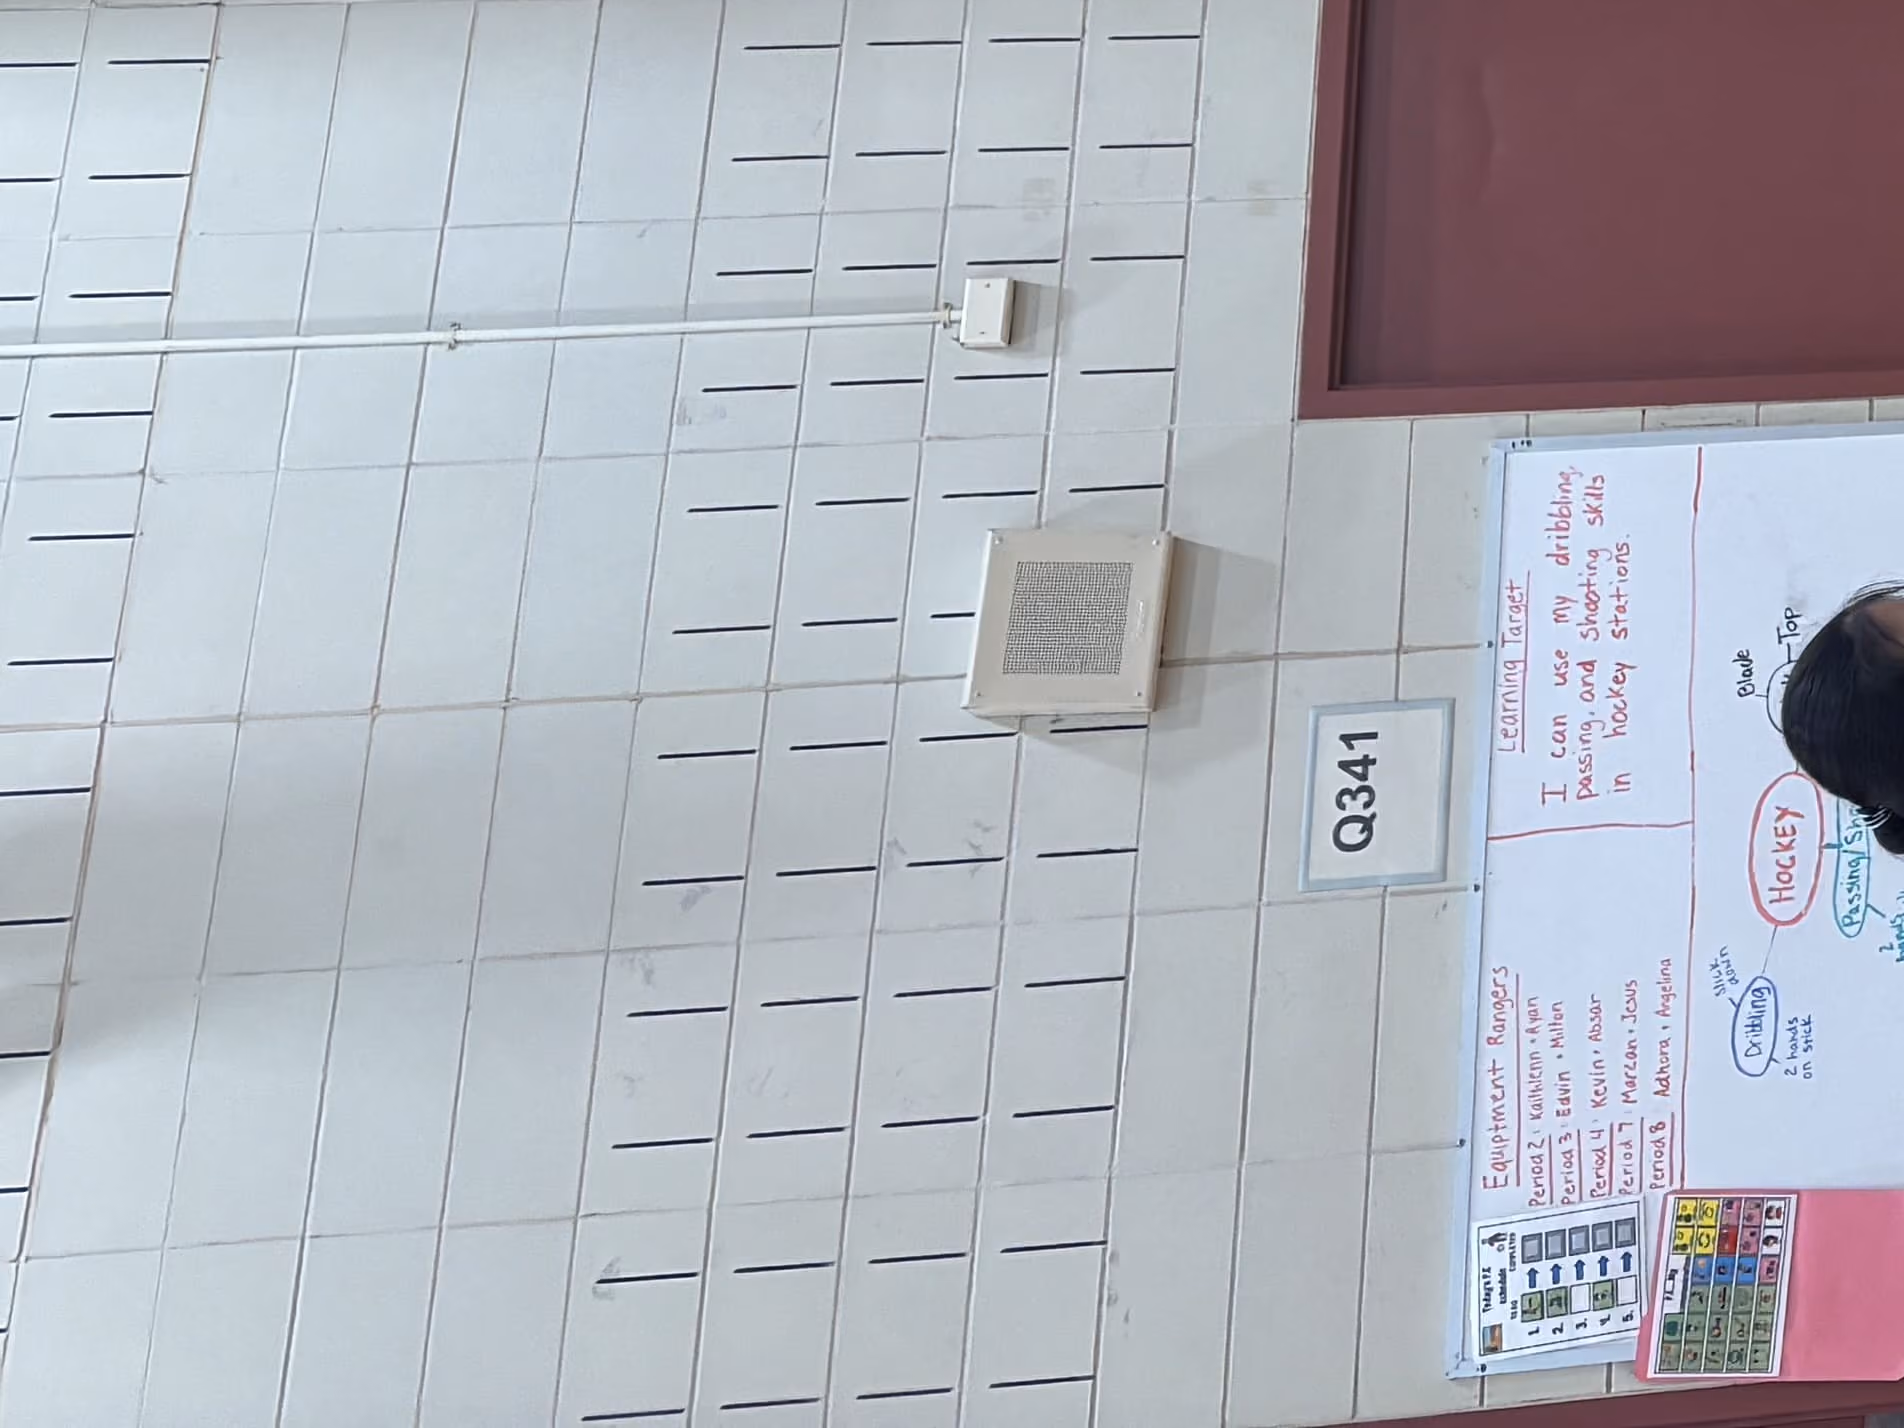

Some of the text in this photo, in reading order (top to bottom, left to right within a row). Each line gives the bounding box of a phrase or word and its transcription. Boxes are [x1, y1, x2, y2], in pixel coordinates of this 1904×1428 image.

[1581, 474, 1606, 527] skills
[1553, 596, 1574, 624] my
[1577, 548, 1612, 642] shooting
[1776, 606, 1802, 644] Top
[1496, 578, 1528, 752] Learning Target
[1552, 649, 1570, 686] use
[1576, 659, 1598, 702] and
[1602, 534, 1638, 793] in hockey stations.
[1732, 648, 1756, 698] Blade
[1550, 714, 1568, 758] can
[1332, 731, 1379, 852] Q341
[1541, 782, 1568, 805] I
[1768, 806, 1804, 904] HOCKEY
[1718, 946, 1739, 984] down
[1878, 942, 1894, 952] 2
[1620, 980, 1638, 1024] Jesus
[1654, 958, 1676, 1017] Angelina
[1526, 996, 1543, 1035] Ayan
[1549, 1001, 1564, 1048] Milton
[1588, 993, 1602, 1042] Absar
[1744, 986, 1772, 1058] Dribbling
[1654, 1036, 1672, 1097] Adhora
[1785, 1016, 1798, 1076] 2 hands
[1801, 1014, 1812, 1079] on stick
[1482, 966, 1514, 1190] Equiptment Rangers
[1556, 1072, 1572, 1117] Edvin
[1590, 1060, 1608, 1108] Kevin
[1528, 1152, 1546, 1207] Period
[1560, 1148, 1576, 1204] Period
[1590, 1145, 1608, 1198] Period
[1618, 1140, 1634, 1195] Period
[1650, 1137, 1666, 1189] Period
[1576, 1318, 1587, 1329] 3.
[1622, 1310, 1634, 1322] 5.
